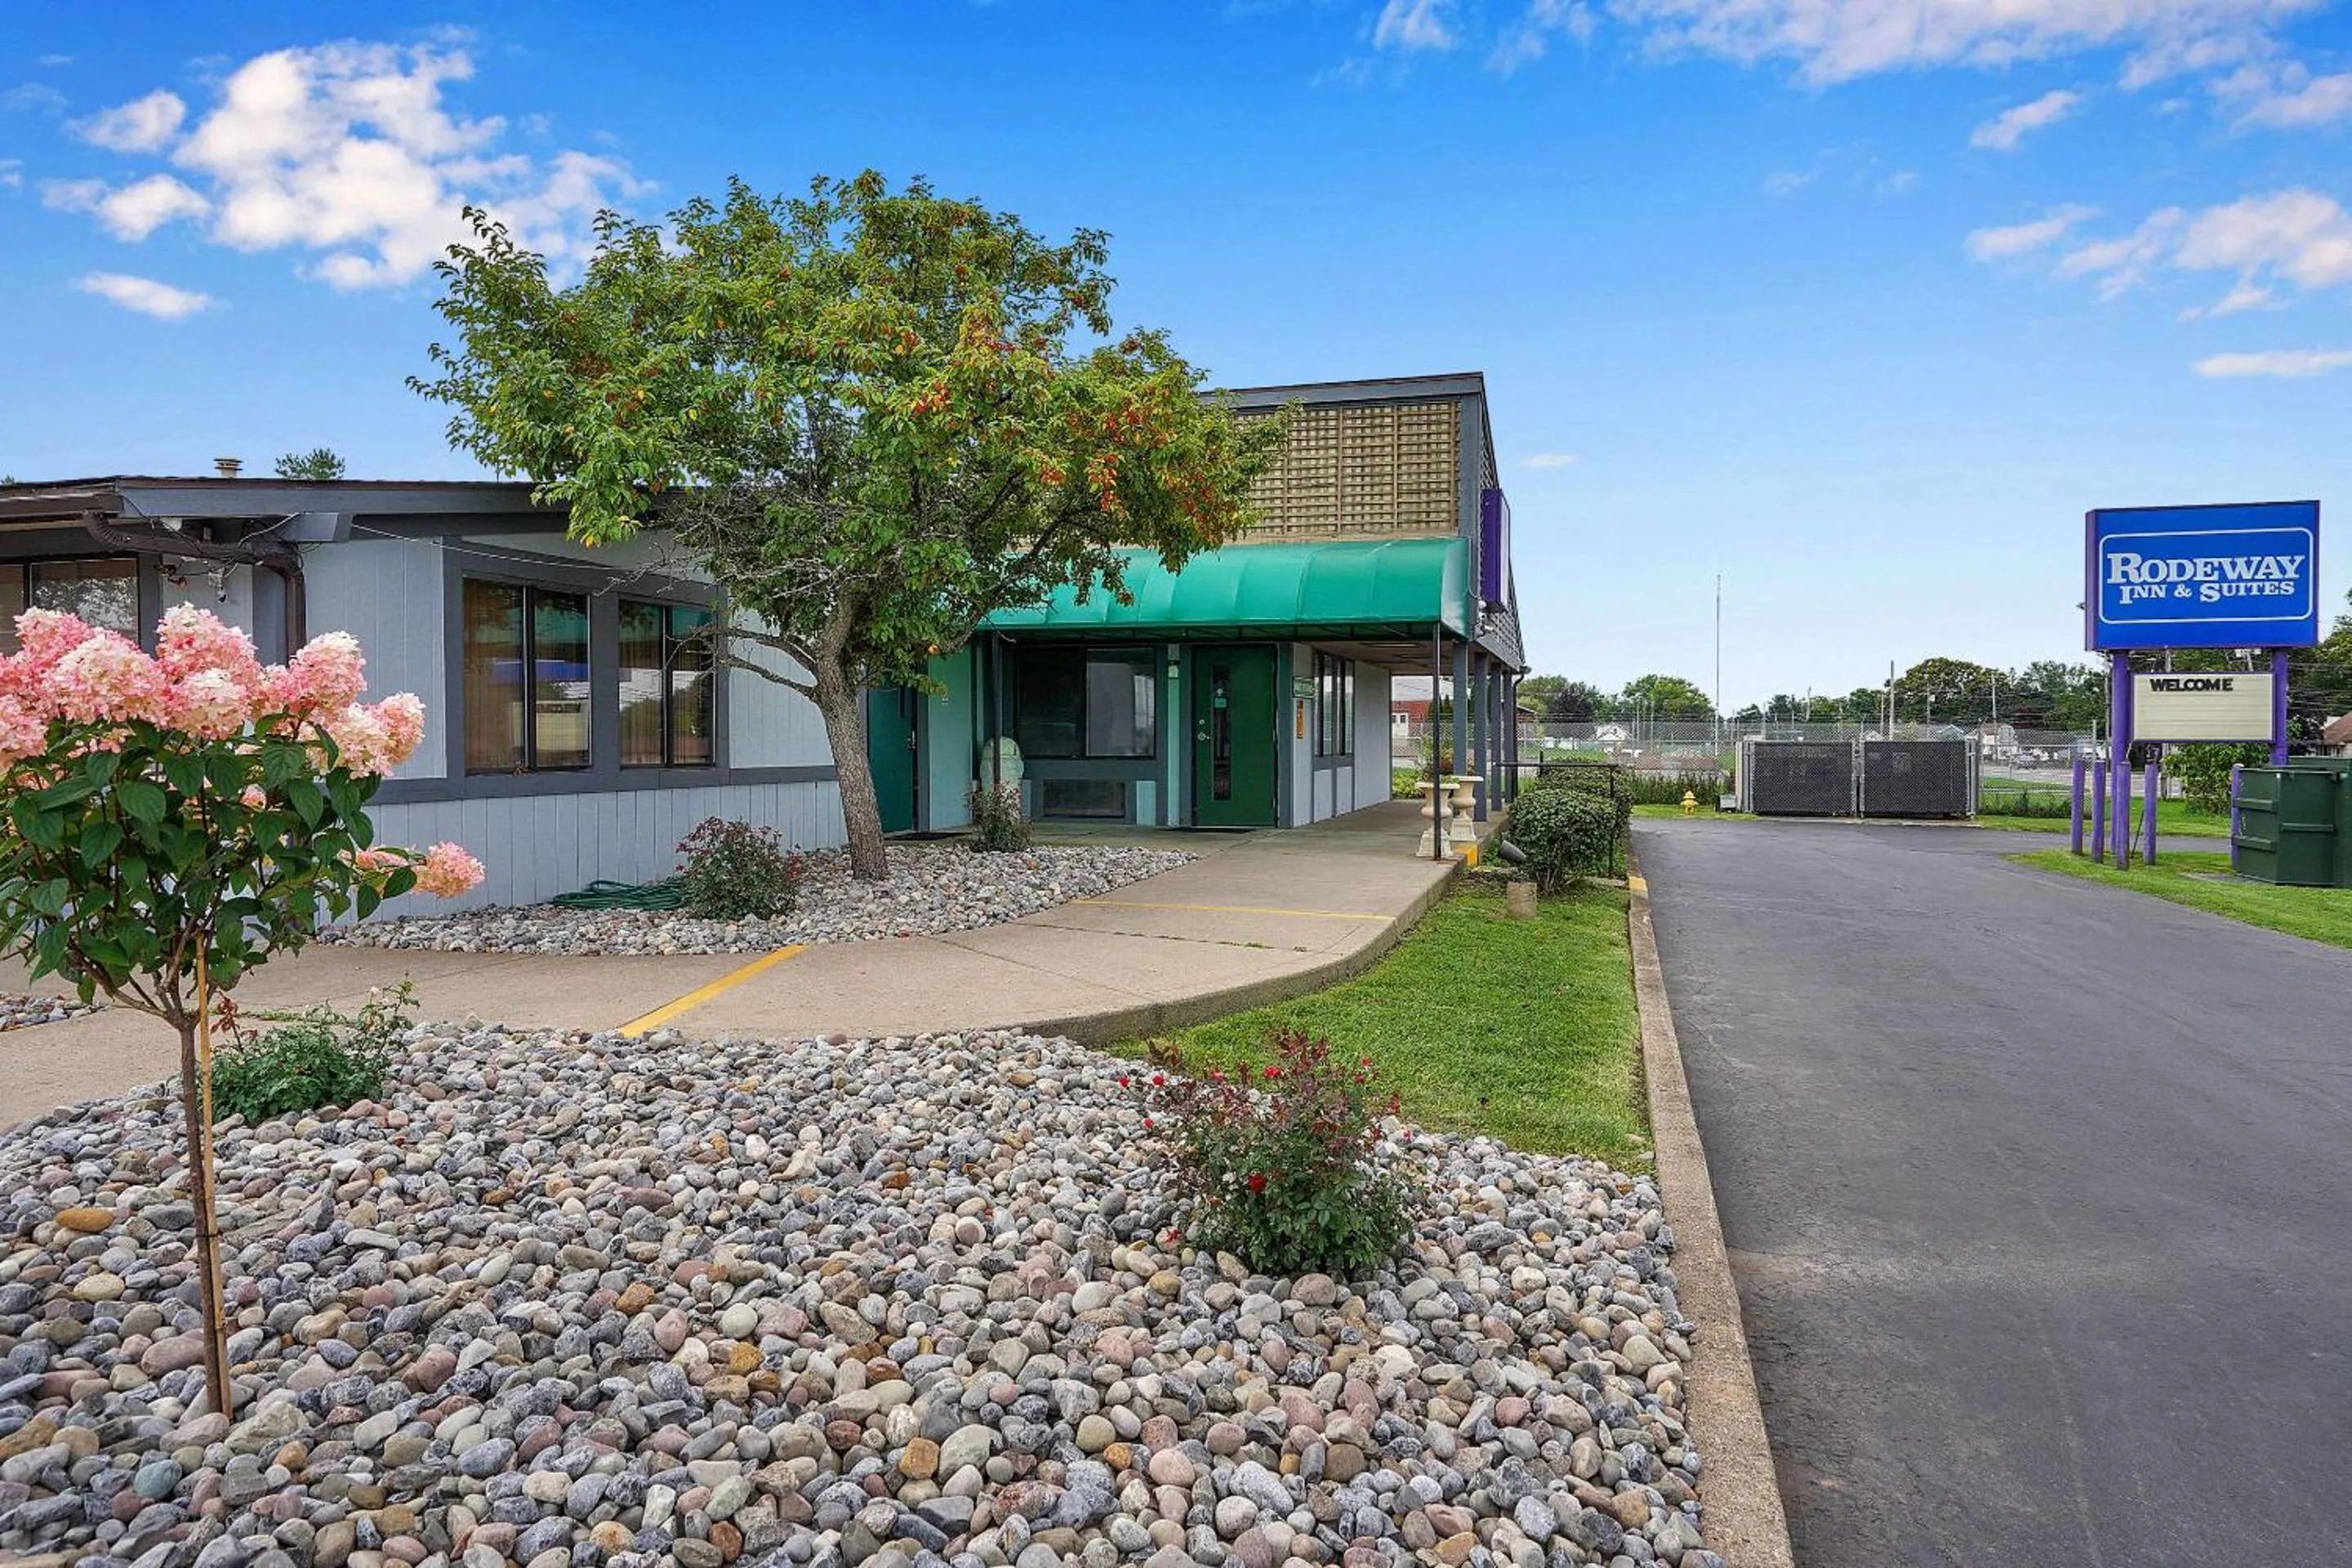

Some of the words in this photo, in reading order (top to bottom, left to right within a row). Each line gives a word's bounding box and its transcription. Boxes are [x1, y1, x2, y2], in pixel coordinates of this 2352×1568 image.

[2107, 553, 2305, 584] RODEWAY
[2119, 584, 2167, 604] INN
[2174, 583, 2192, 599] &
[2199, 581, 2296, 603] SUITES
[2149, 678, 2234, 692] WELCOME
